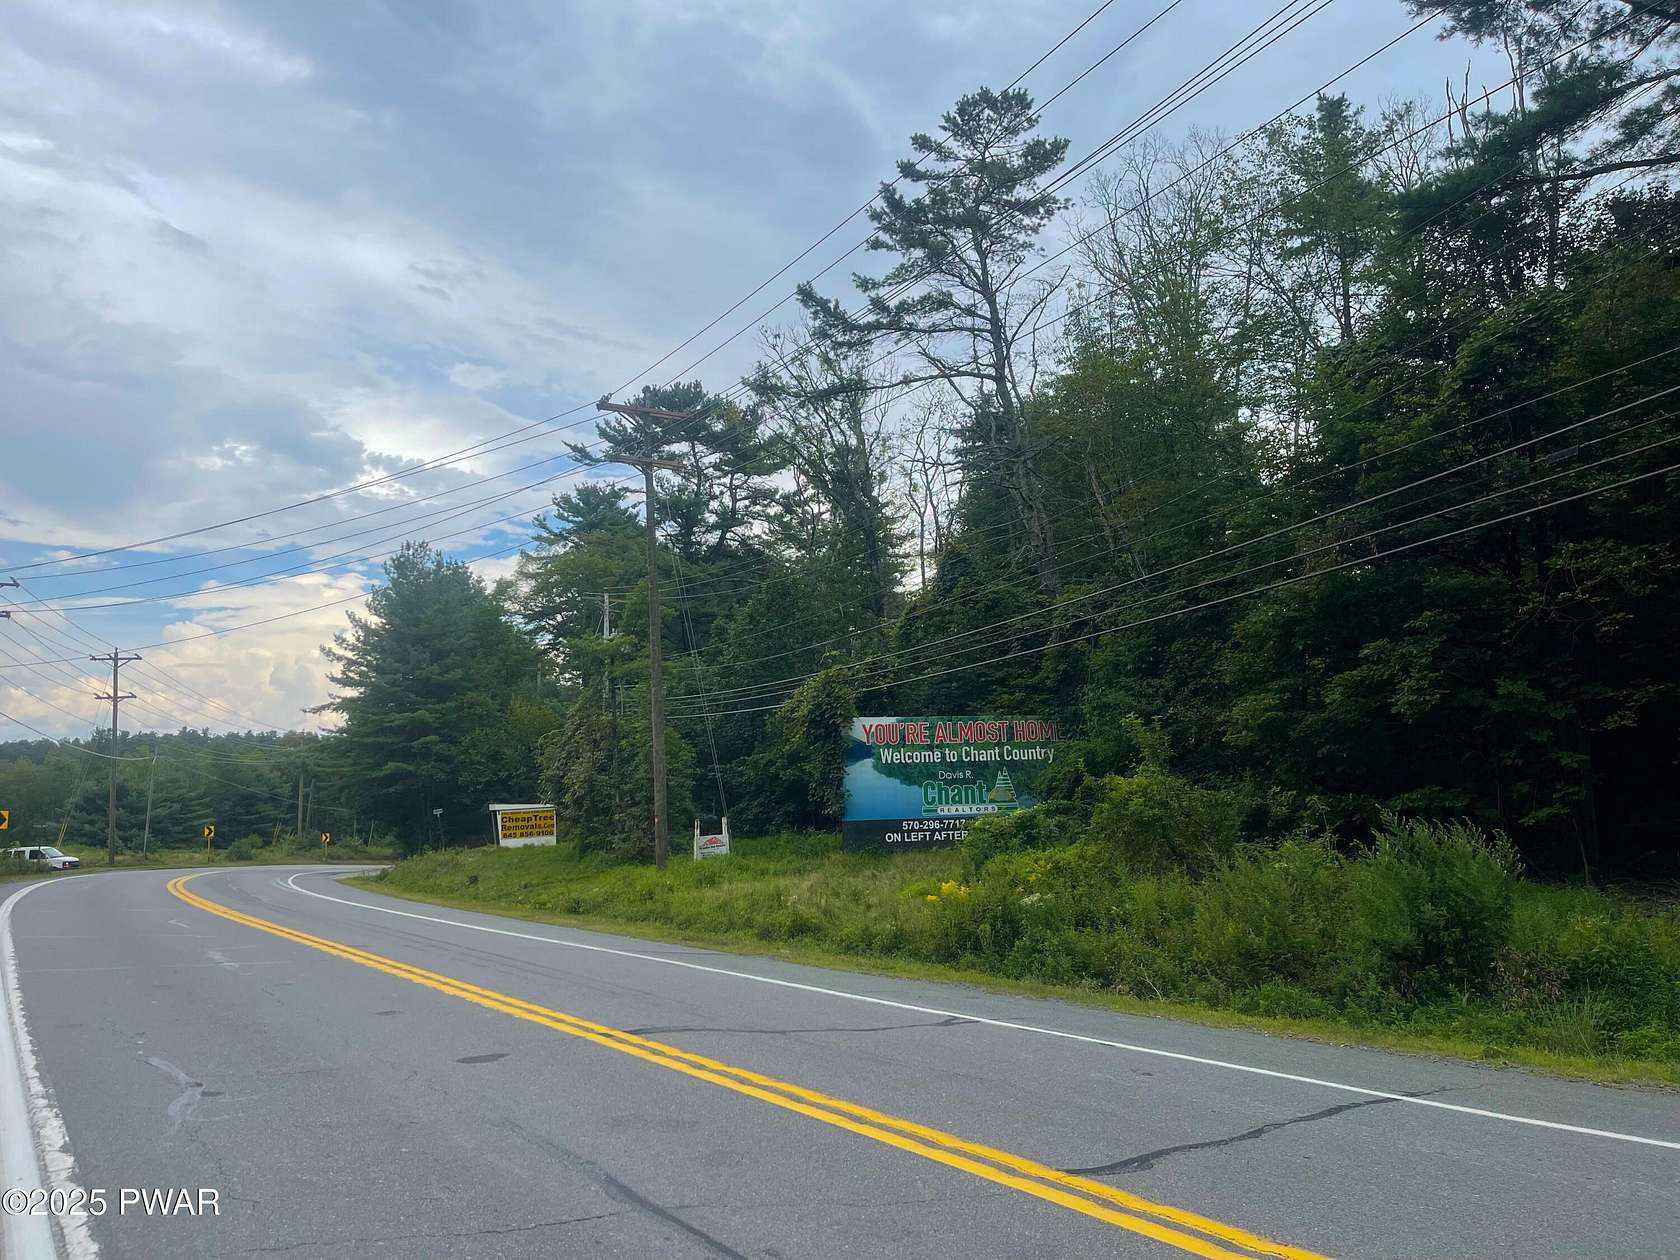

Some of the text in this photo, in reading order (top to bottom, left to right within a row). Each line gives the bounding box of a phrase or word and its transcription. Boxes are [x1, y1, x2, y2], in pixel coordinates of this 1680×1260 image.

[862, 721, 930, 745] YOU'RE
[935, 720, 1008, 744] ALMOST
[880, 745, 1054, 764] Welcome to Chant Country
[938, 770, 974, 779] Davis R.
[922, 780, 986, 807] Chant
[939, 806, 997, 814] REALTORS
[501, 814, 555, 824] CheapTree
[885, 832, 902, 843] ON
[904, 831, 932, 842] LEFT
